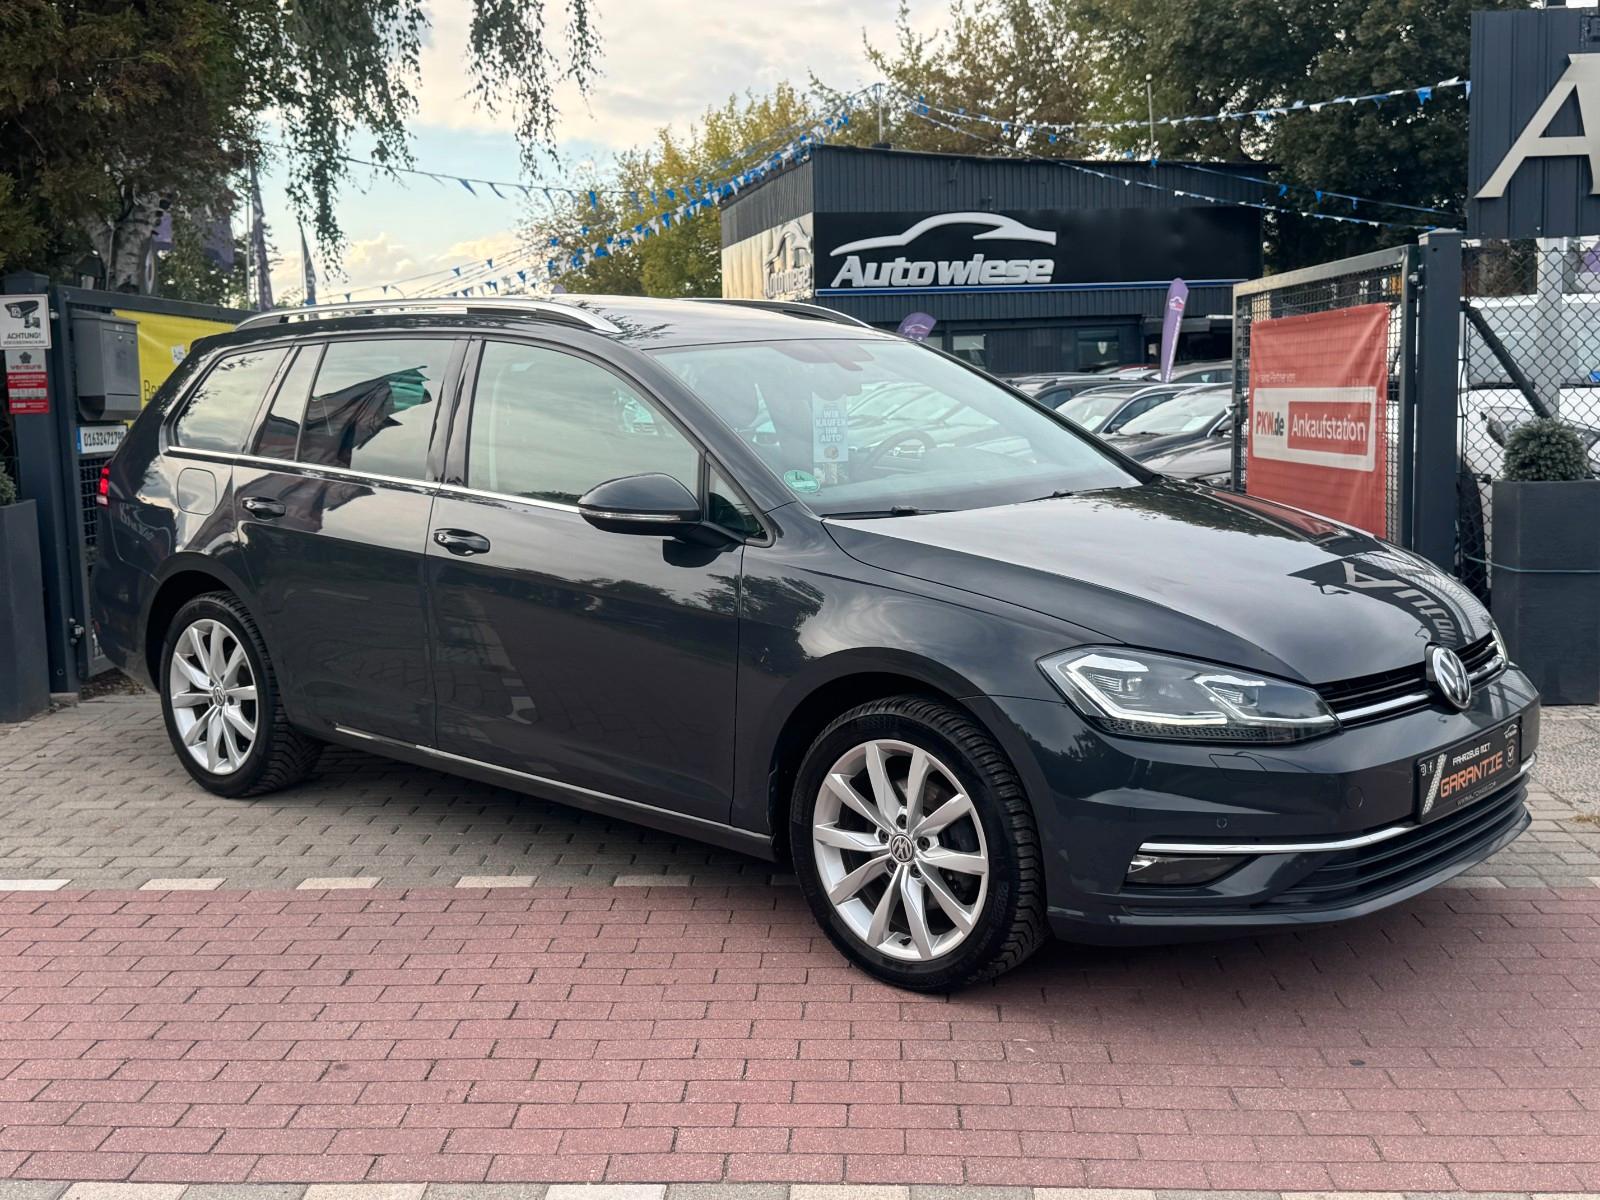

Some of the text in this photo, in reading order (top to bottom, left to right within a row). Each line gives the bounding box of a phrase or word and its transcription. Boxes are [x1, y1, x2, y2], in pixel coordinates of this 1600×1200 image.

[1474, 53, 1600, 198] A
[830, 253, 1055, 288] Autowiese
[7, 332, 41, 340] ACHTUNG!
[820, 434, 842, 442] AUTO
[1256, 411, 1366, 442] PKW.de Ankaufstation
[1440, 750, 1503, 798] GARANTIE
